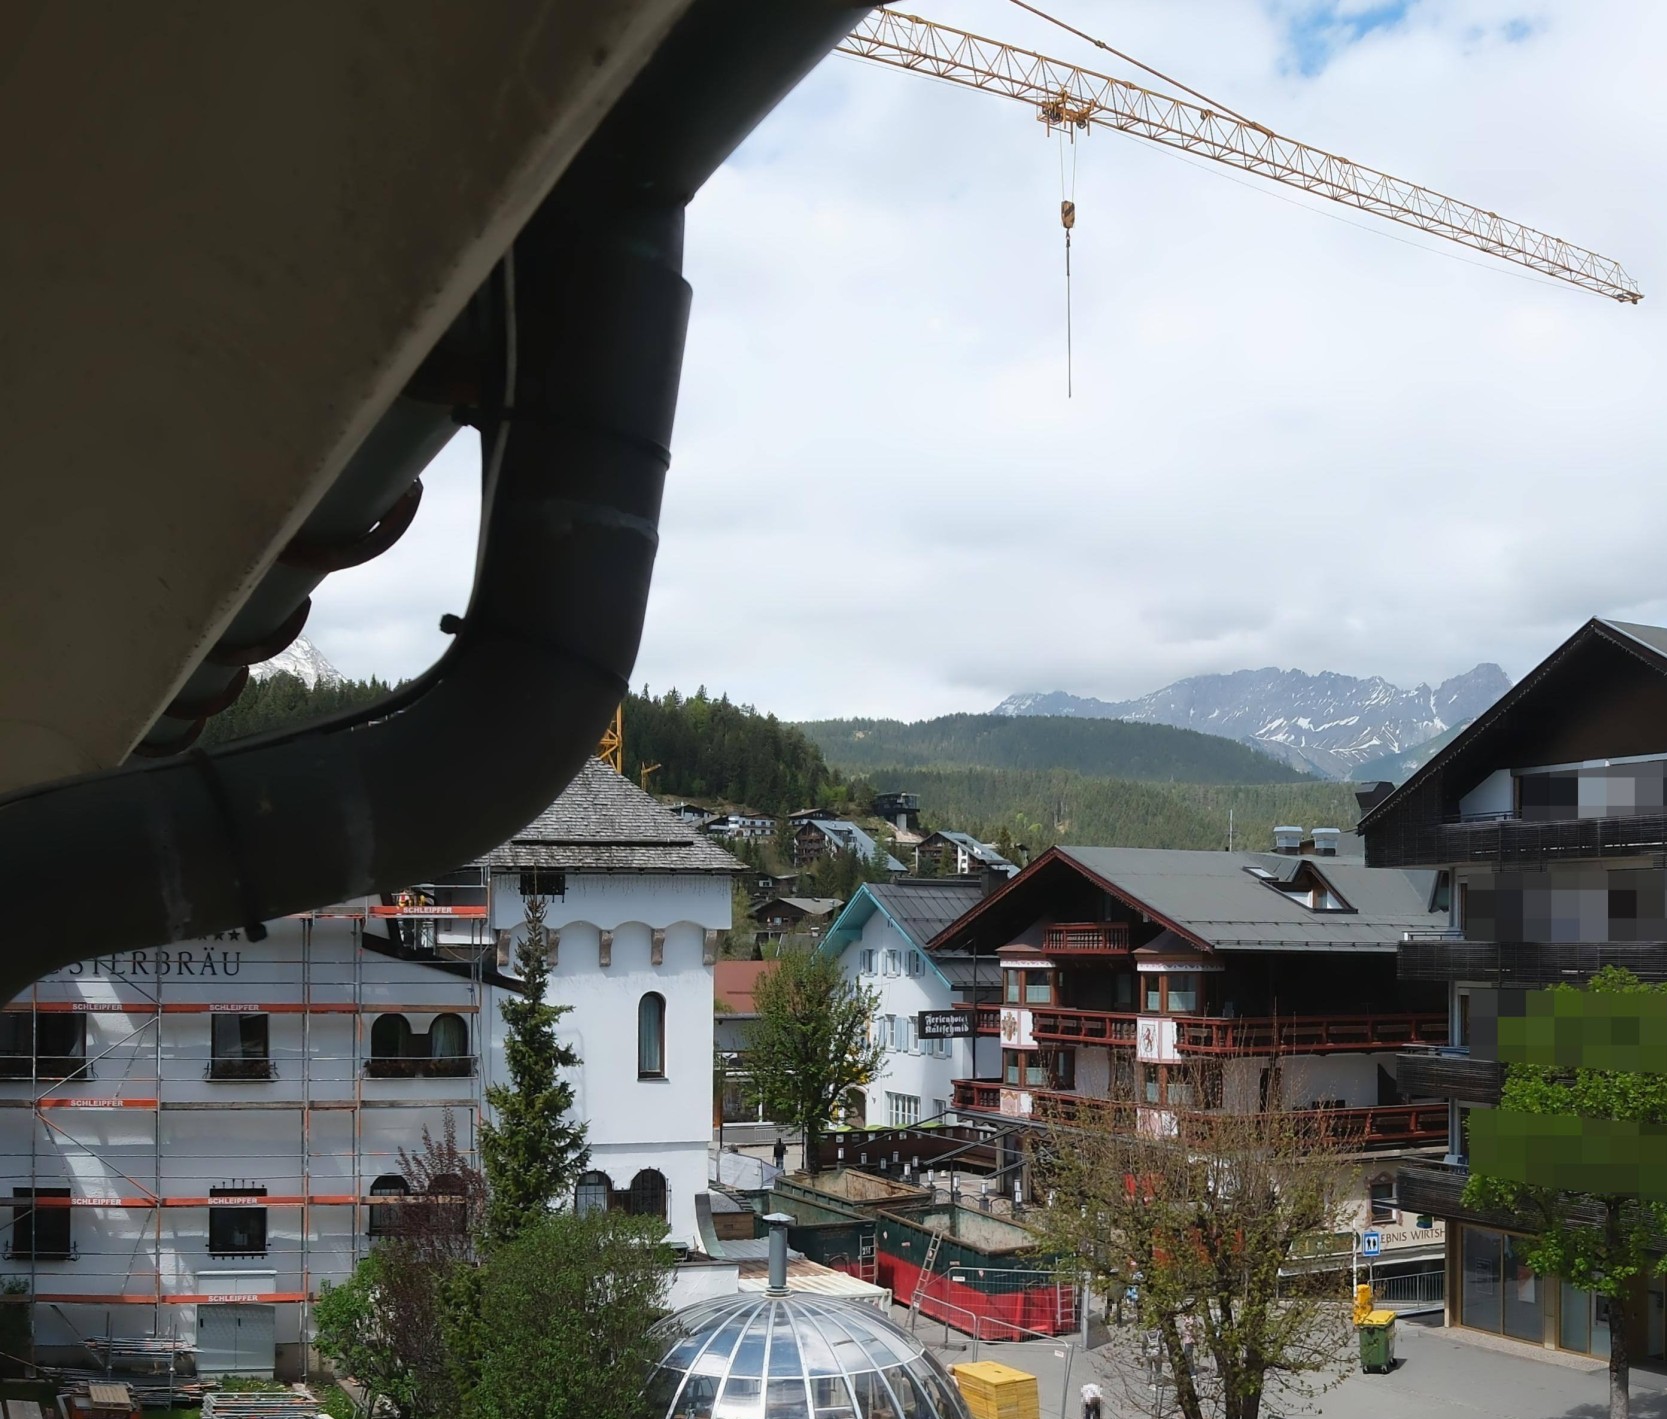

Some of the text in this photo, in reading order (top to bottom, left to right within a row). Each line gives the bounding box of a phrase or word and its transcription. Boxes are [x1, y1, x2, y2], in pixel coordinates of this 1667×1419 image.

[403, 906, 452, 914] SCHLEIPFER
[72, 1003, 123, 1011] SCHLEIPFER
[71, 1198, 122, 1206] SCHLEIPFER
[208, 1197, 258, 1205] SCHLEIPFER
[1379, 1231, 1407, 1244] EBNIS
